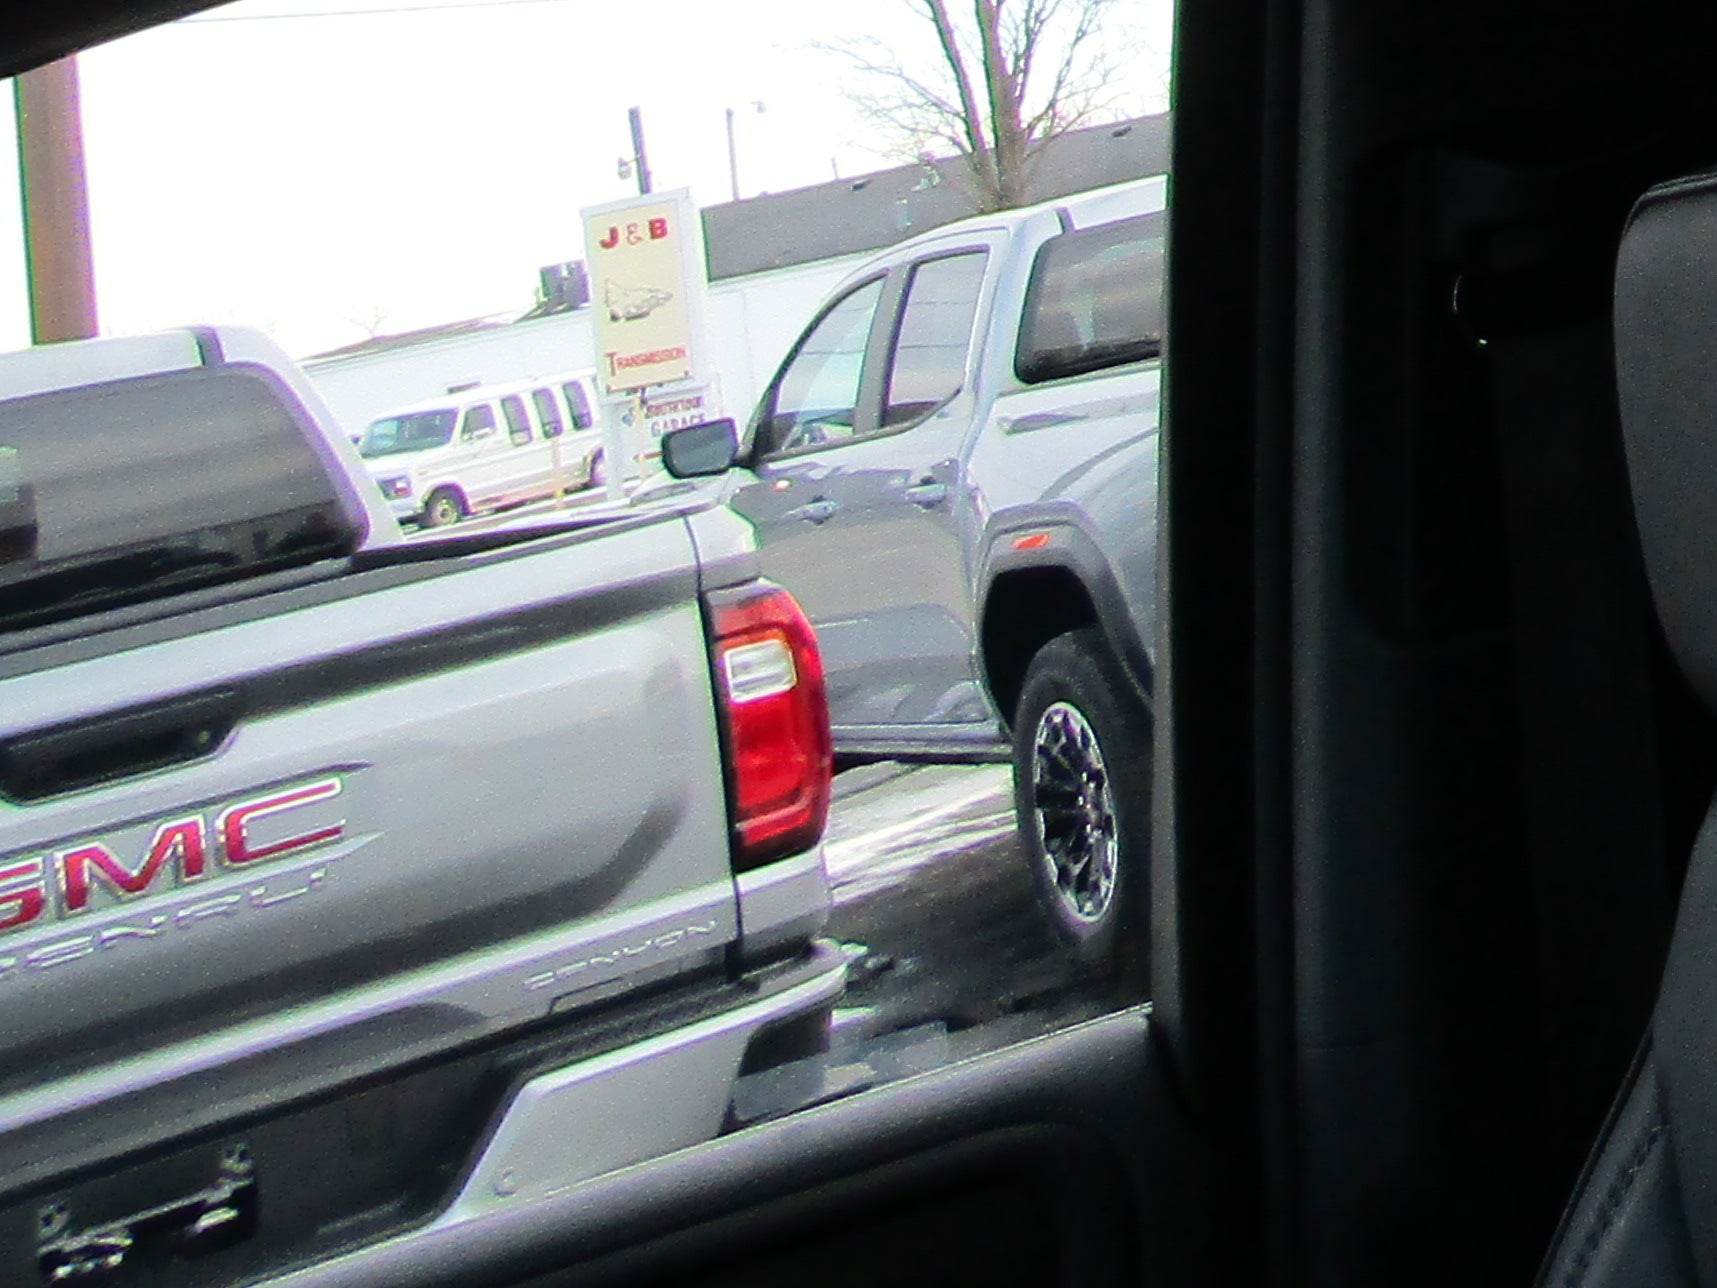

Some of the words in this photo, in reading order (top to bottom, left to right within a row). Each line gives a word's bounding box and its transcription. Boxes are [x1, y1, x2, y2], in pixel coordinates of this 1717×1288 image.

[599, 226, 619, 250] J
[626, 222, 643, 246] &
[648, 217, 669, 240] B
